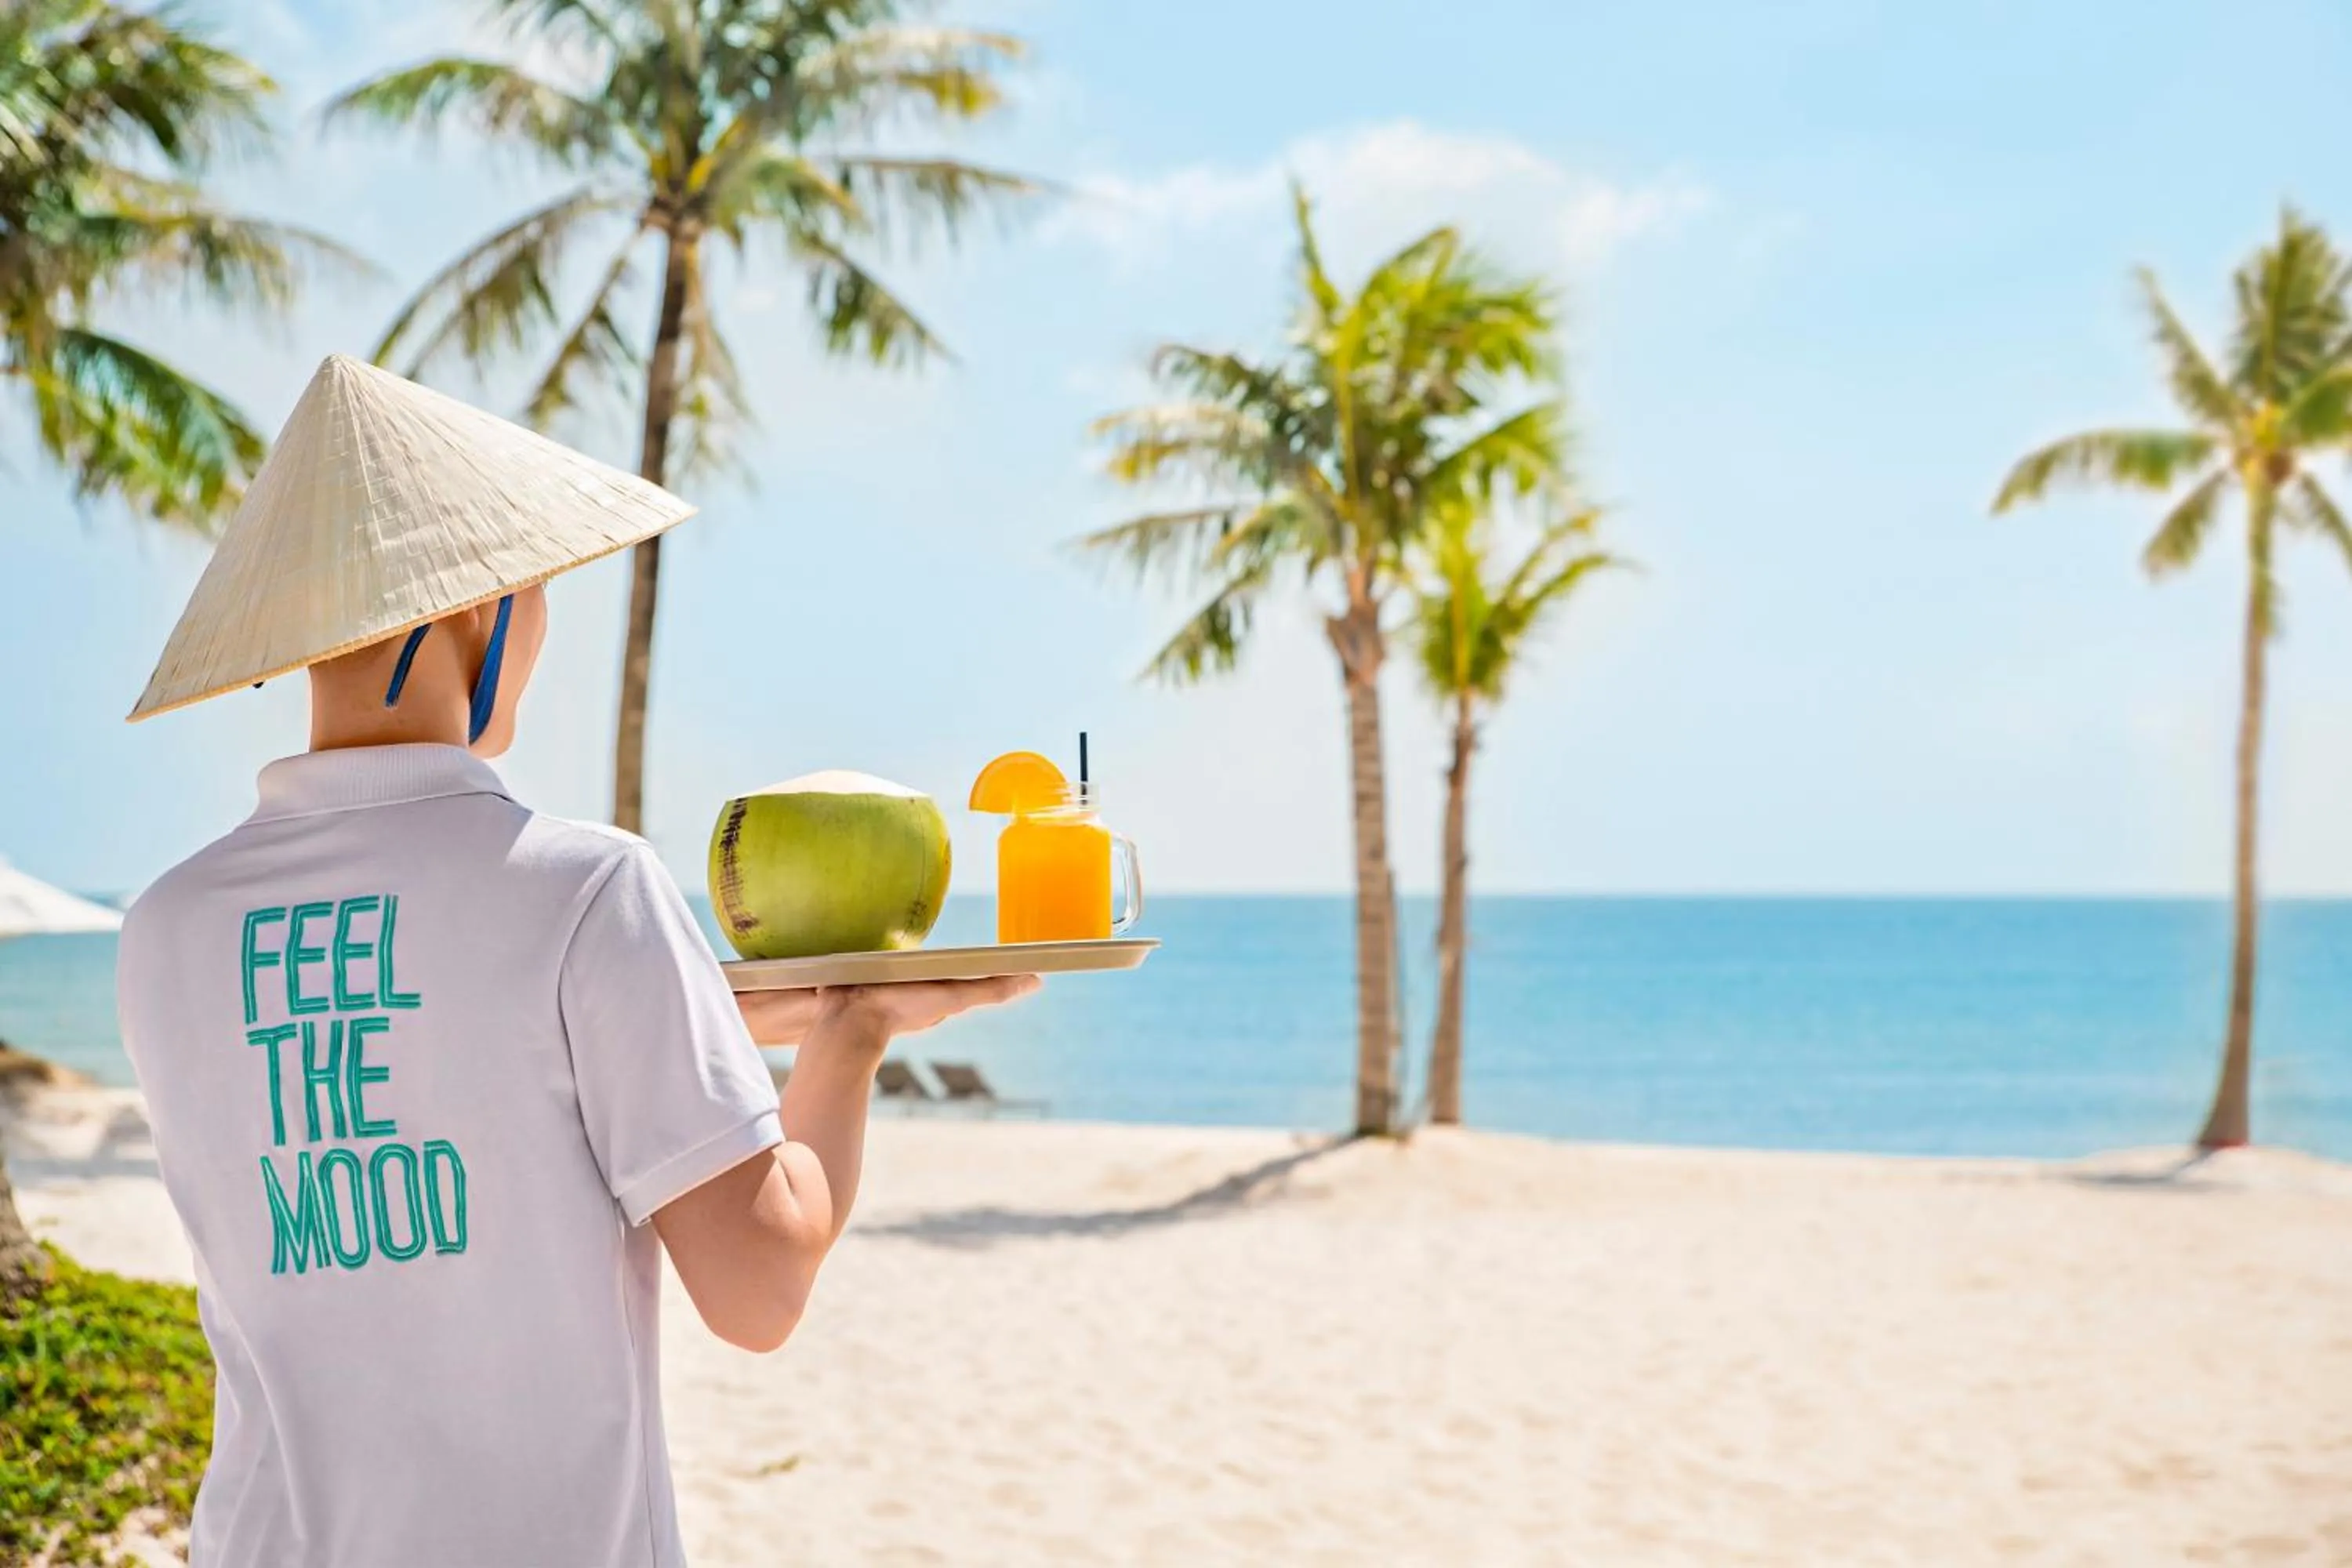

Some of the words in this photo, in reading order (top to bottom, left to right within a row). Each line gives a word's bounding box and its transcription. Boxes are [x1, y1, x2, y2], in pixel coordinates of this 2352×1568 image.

[241, 894, 422, 1025] FEEL
[245, 1016, 398, 1146] THE
[259, 1139, 468, 1276] MOOD
